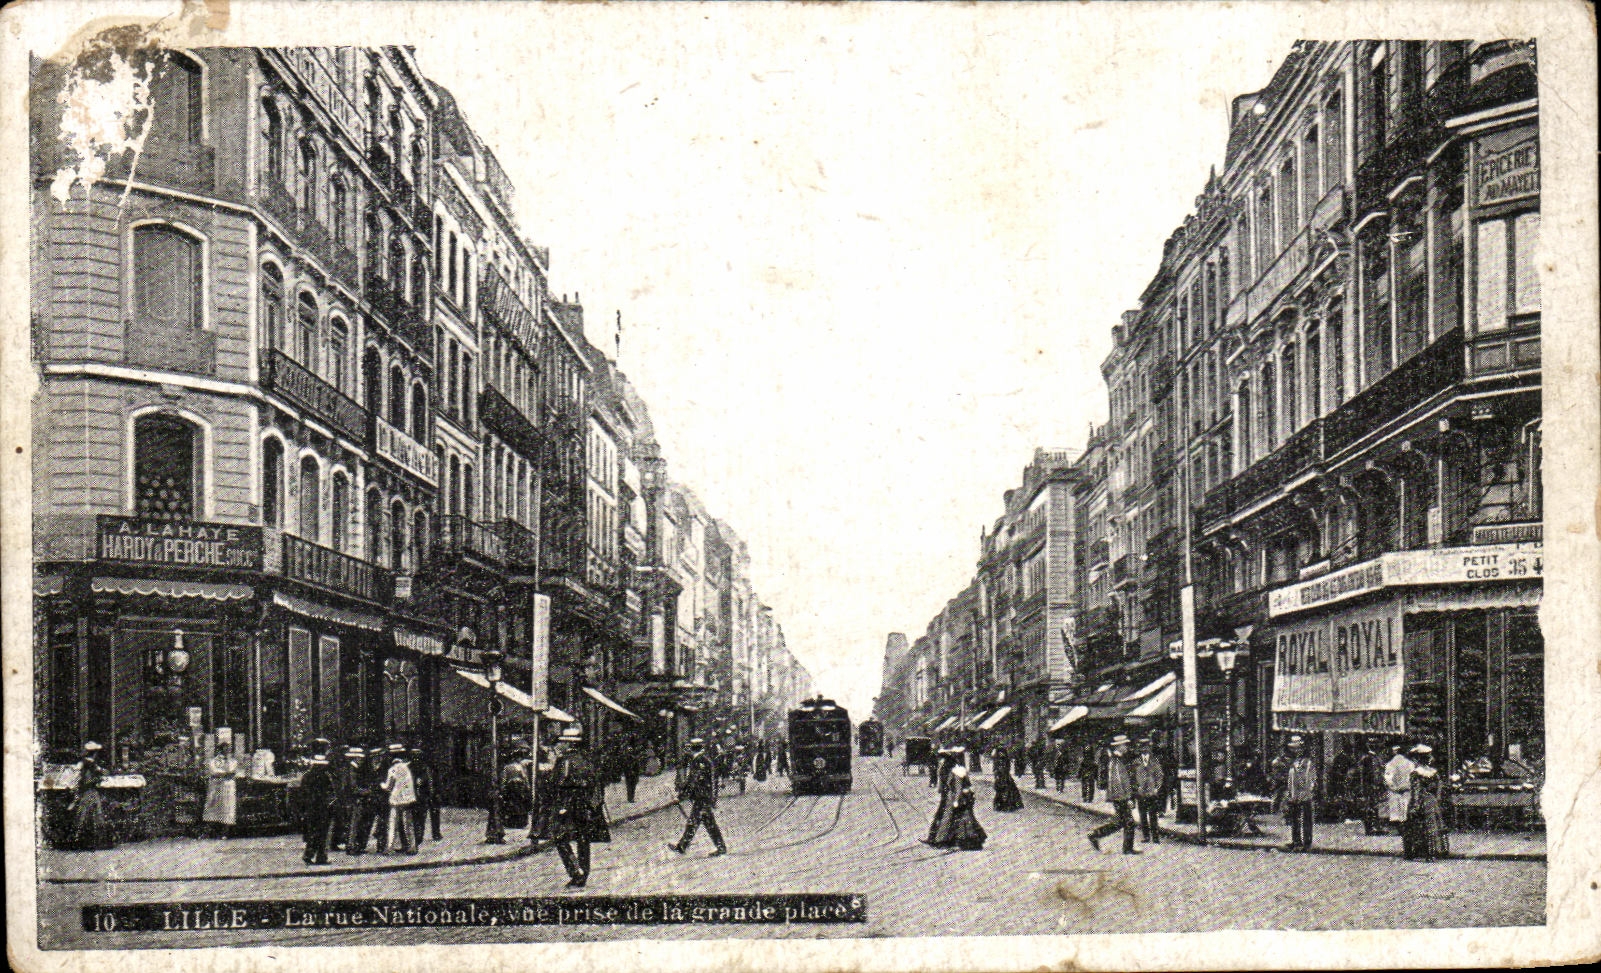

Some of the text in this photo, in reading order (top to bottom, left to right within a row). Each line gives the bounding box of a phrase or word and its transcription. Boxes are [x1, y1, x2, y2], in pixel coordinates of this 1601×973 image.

[147, 523, 239, 541] LAHAYE
[102, 534, 154, 561] HARDY
[163, 538, 225, 566] PERCHE
[1463, 555, 1498, 566] PETIT
[1467, 568, 1499, 579] CLOS
[1277, 617, 1397, 676] ROYAL ROYAL
